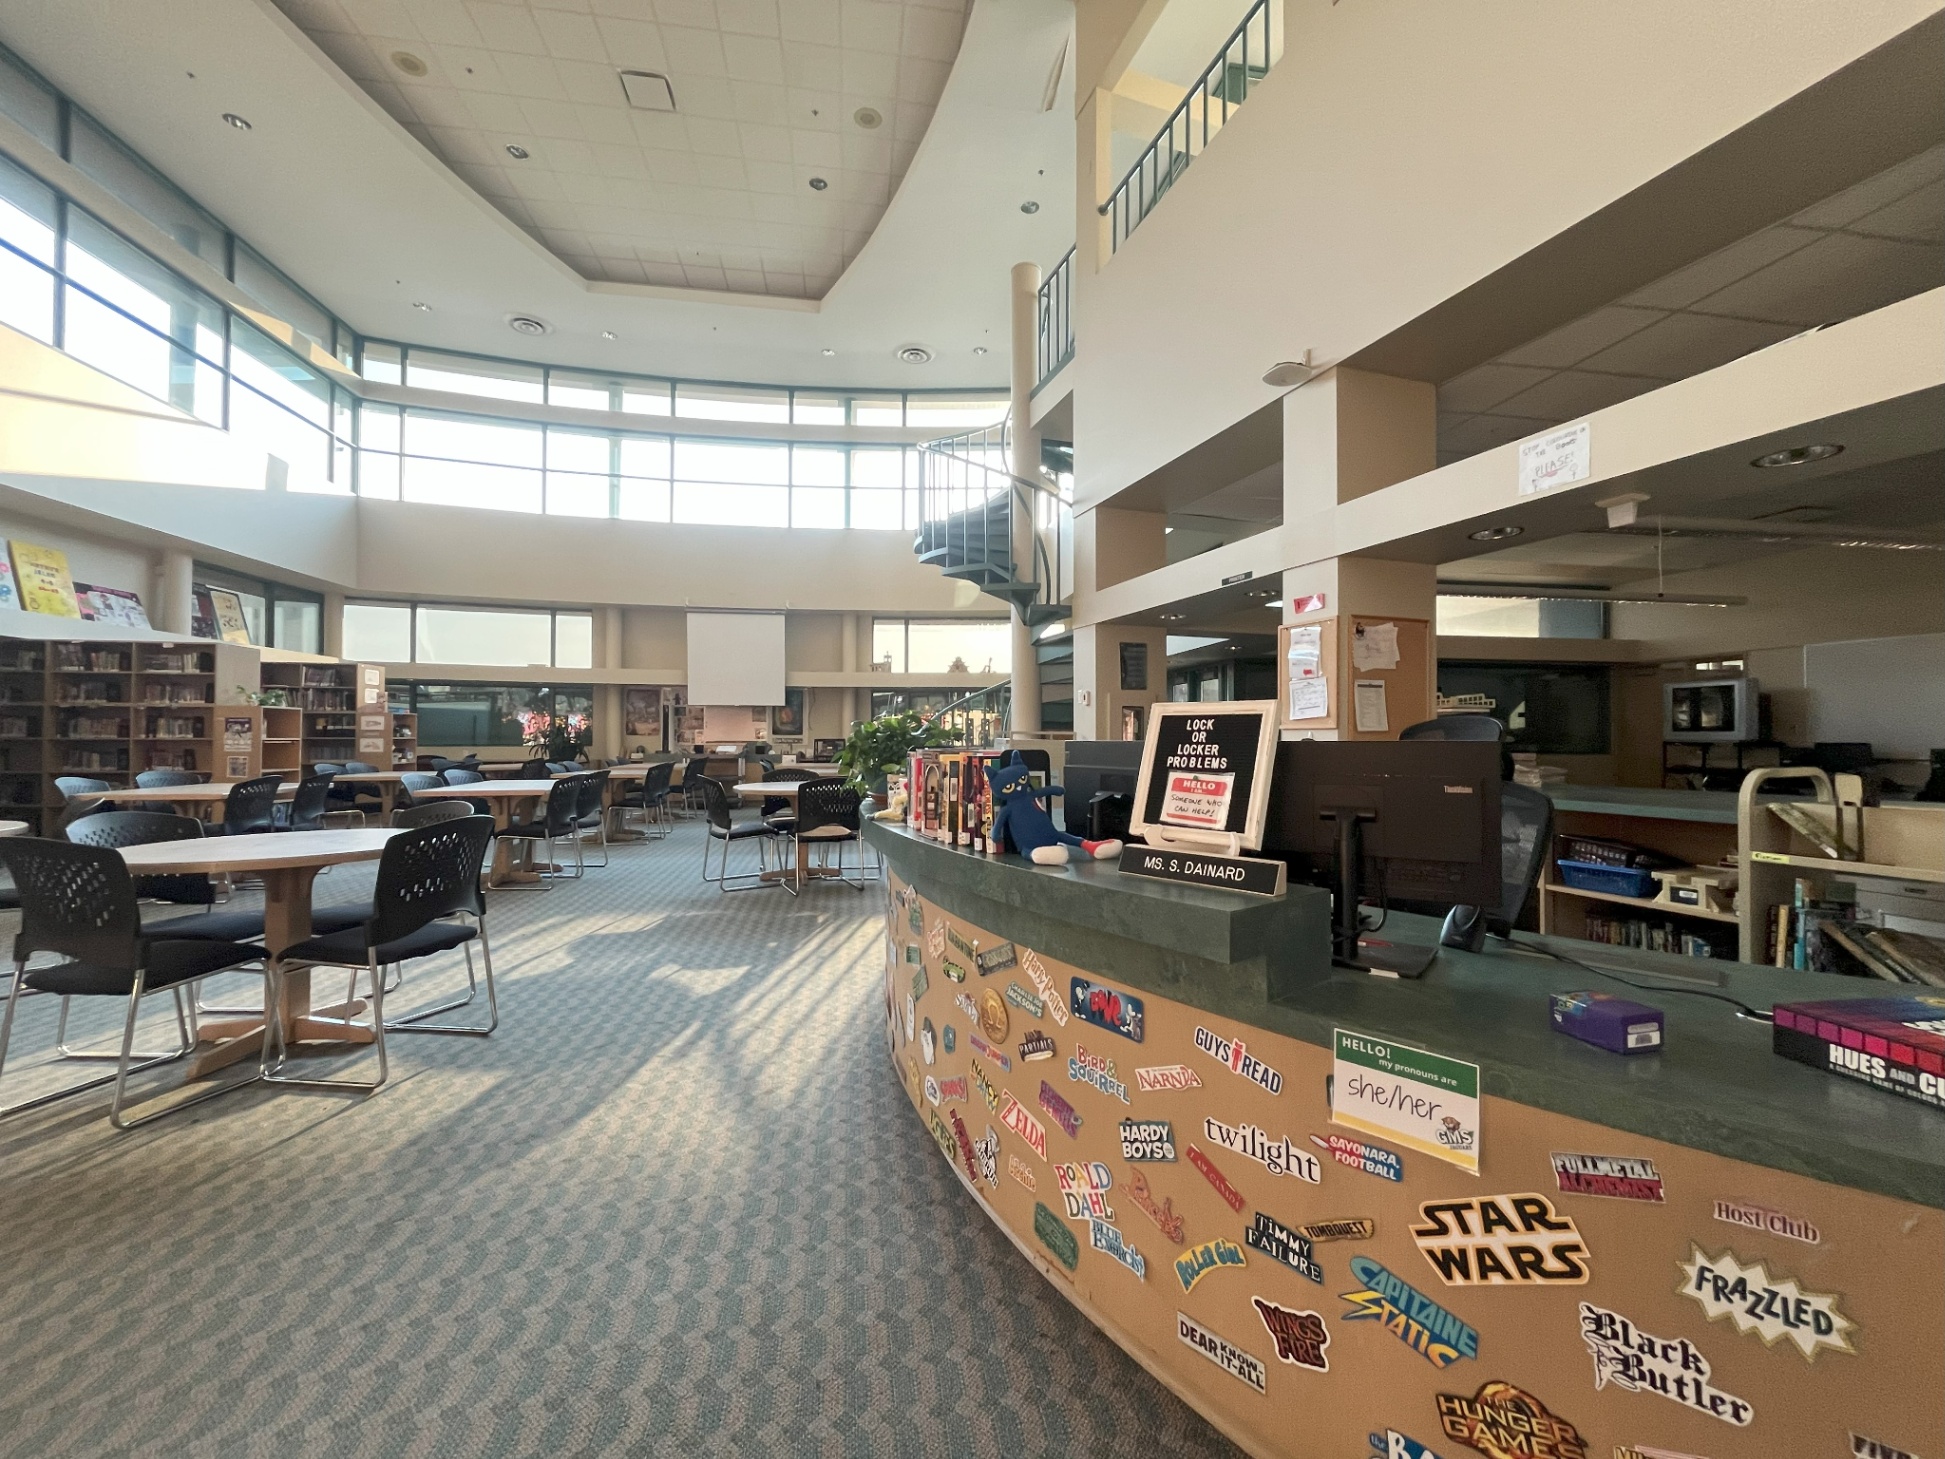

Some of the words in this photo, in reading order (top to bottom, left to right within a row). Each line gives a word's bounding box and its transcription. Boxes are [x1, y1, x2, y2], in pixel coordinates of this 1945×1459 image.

[1186, 718, 1215, 731] LOCK
[1191, 731, 1207, 743] OR
[1166, 756, 1228, 769] PROBLEMS
[1177, 744, 1219, 756] LOCKER
[1182, 780, 1216, 790] HELLO
[1171, 794, 1203, 806] SOMEONE
[1206, 799, 1223, 807] WHO
[1174, 805, 1189, 813] CAN
[1191, 808, 1215, 817] HELP!
[1144, 855, 1165, 871] MS.
[1169, 859, 1181, 874] S.
[1184, 861, 1246, 881] DAINARD
[1006, 986, 1043, 1018] JACKSON'S
[1089, 989, 1122, 1027] BONE
[1019, 1038, 1053, 1055] PARTIALS
[1195, 1027, 1231, 1063] GUYS
[1241, 1054, 1282, 1094] READ
[1342, 1036, 1391, 1059] HELLO!
[1137, 1066, 1201, 1090] NARNIA
[1378, 1059, 1394, 1069] my
[1394, 1064, 1439, 1081] pronouns
[1440, 1076, 1458, 1087] are
[1829, 1043, 1886, 1079] HUES
[1889, 1068, 1915, 1085] AND
[1348, 1073, 1442, 1120] she/her
[1001, 1090, 1046, 1160] ZELDA
[1119, 1125, 1169, 1142] HARDY
[1435, 1129, 1474, 1145] GMS
[1123, 1142, 1164, 1159] BOYS
[1205, 1117, 1319, 1183] twilight
[1055, 1162, 1112, 1190] ROALD
[1335, 1151, 1397, 1180] FOOTBALL
[1555, 1156, 1660, 1181] FULLMETAL
[1065, 1191, 1114, 1220] DAHL
[1414, 1197, 1570, 1238] STAR
[1304, 1220, 1368, 1239] TOMBQUEST
[1248, 1228, 1322, 1283] FAILURE
[1425, 1244, 1584, 1281] WARS
[1695, 1265, 1834, 1336] FRAZZLED
[1254, 1299, 1325, 1342] WINGS
[1180, 1320, 1219, 1358] DEAR
[1276, 1331, 1325, 1367] FIRE
[1580, 1304, 1707, 1377] Black
[1220, 1353, 1265, 1391] IT-ALL
[1609, 1345, 1749, 1424] Butler
[1438, 1395, 1580, 1446] HUNGER
[1442, 1415, 1586, 1459] GAMES
